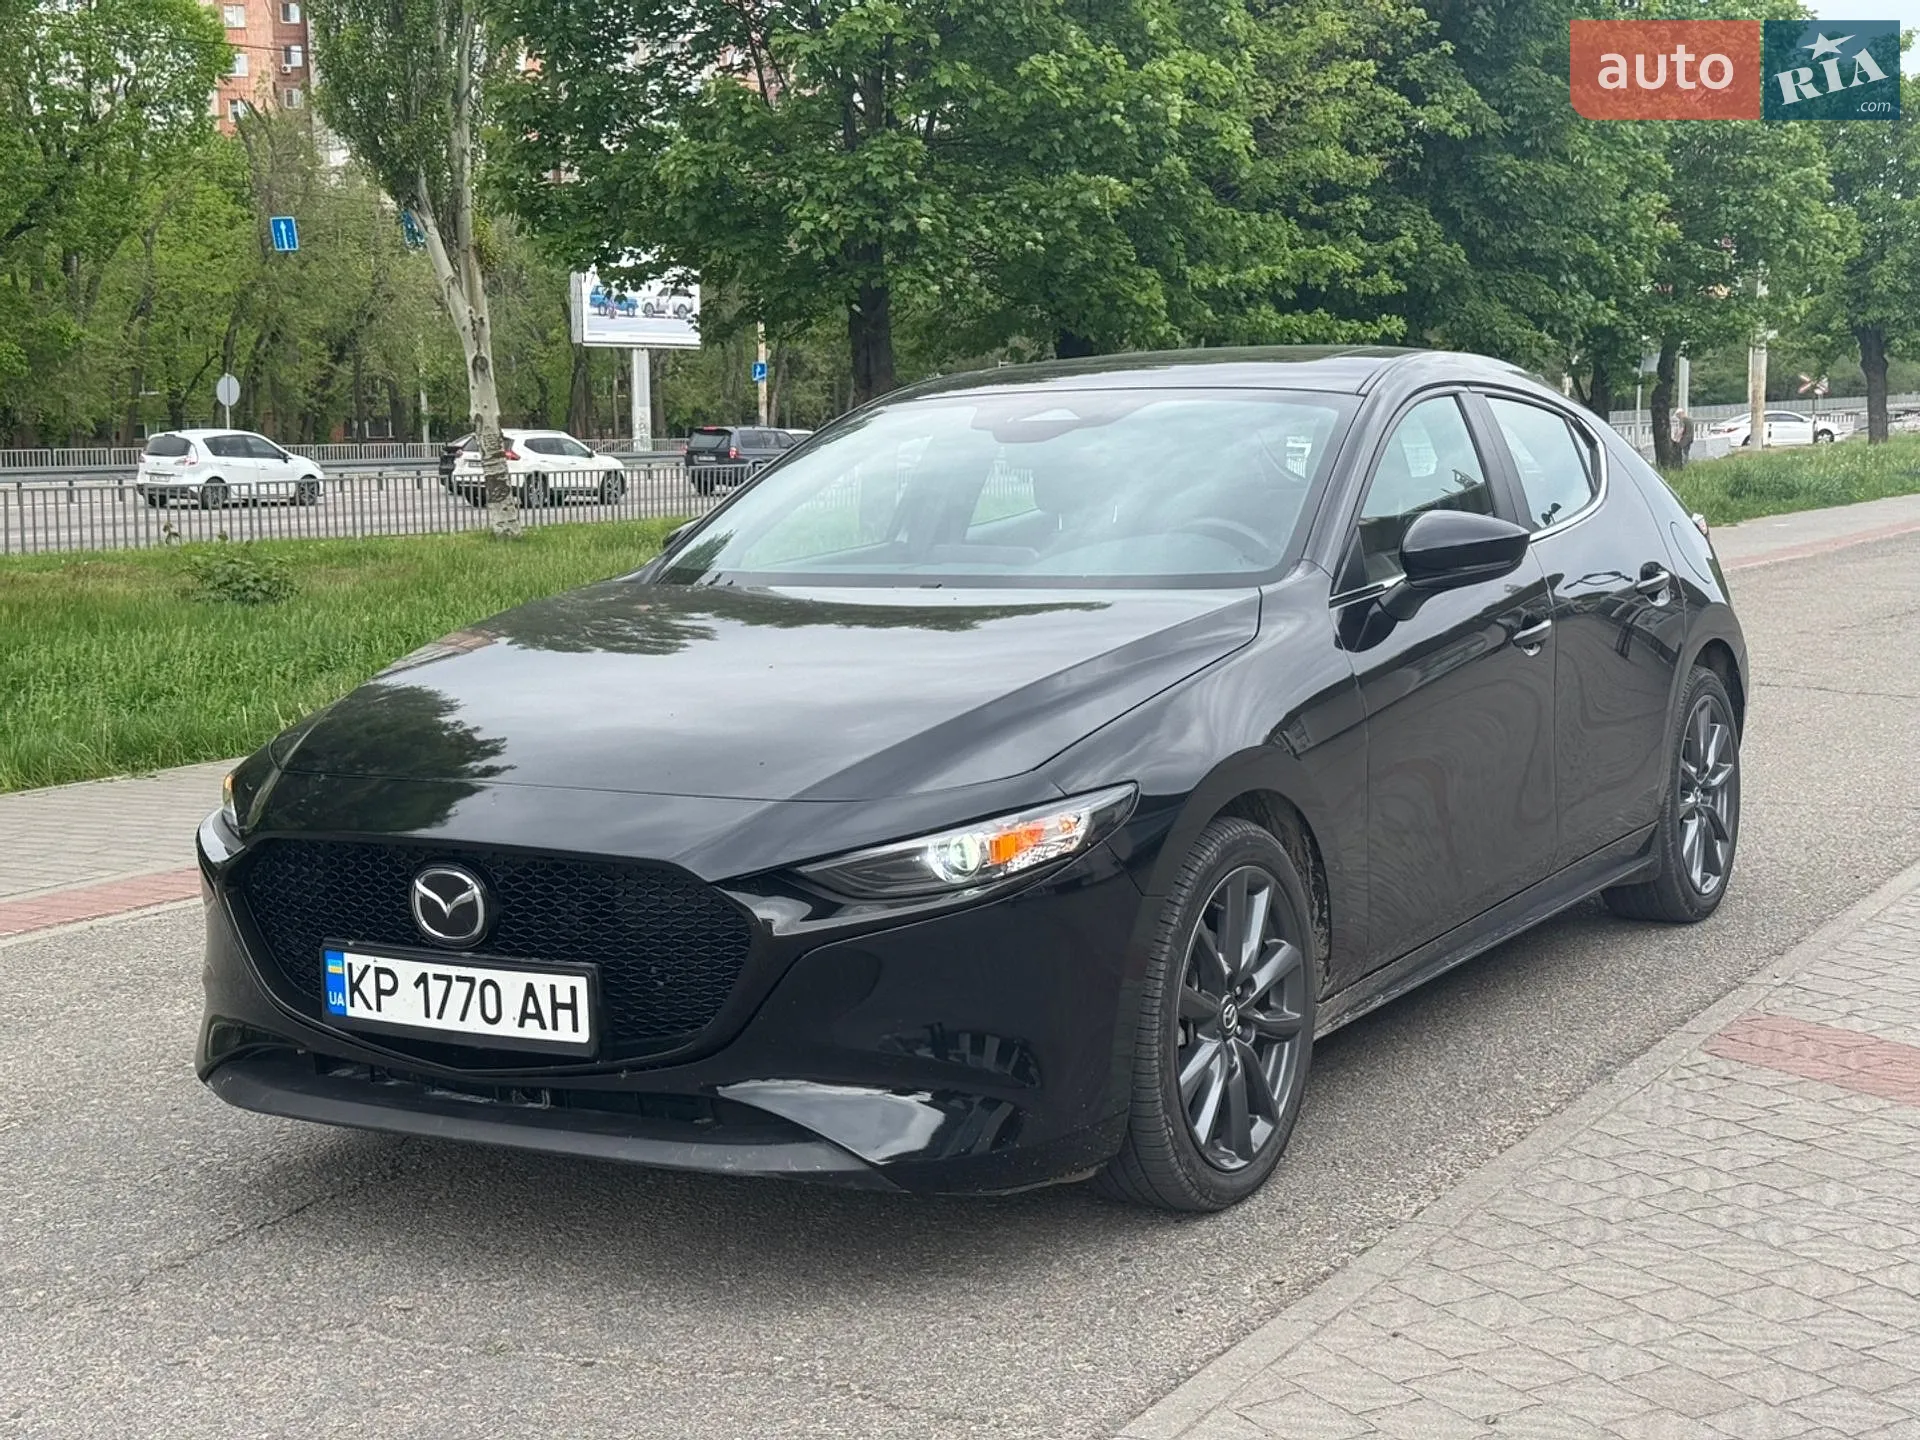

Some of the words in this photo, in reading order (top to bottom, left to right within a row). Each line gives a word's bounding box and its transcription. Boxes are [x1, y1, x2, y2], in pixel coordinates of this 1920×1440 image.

[329, 991, 345, 1006] UA
[347, 962, 399, 1012] KP
[413, 971, 502, 1025] 1770
[517, 982, 579, 1033] AH
